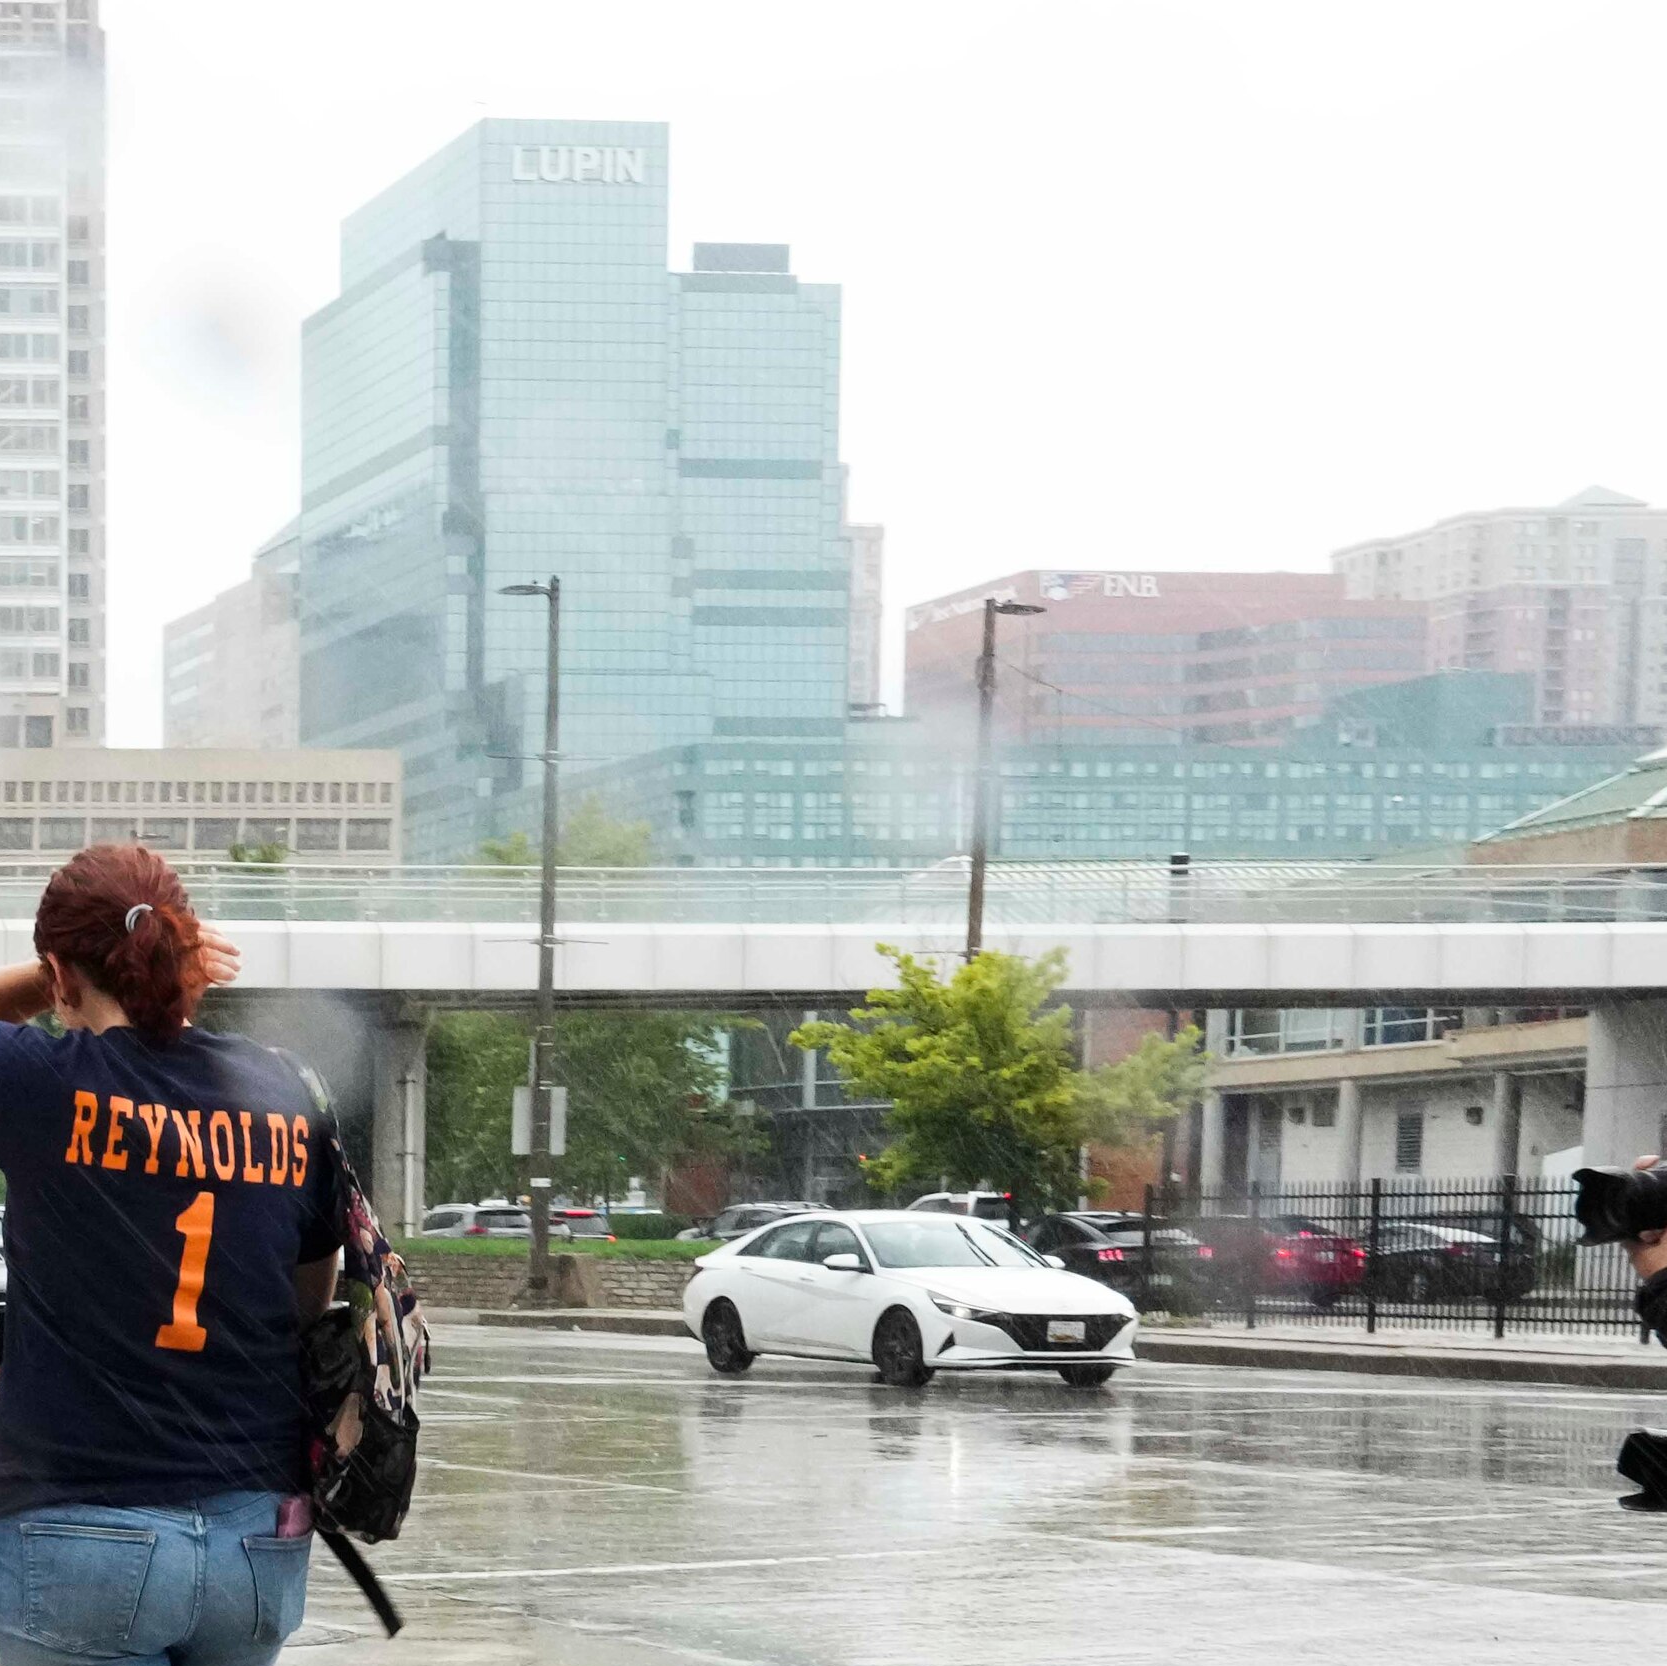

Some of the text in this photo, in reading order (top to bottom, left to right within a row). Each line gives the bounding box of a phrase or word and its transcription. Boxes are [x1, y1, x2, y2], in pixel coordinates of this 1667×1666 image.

[513, 146, 644, 184] LUPIN
[65, 1090, 309, 1187] REYNOLDS
[155, 1191, 215, 1352] 1
